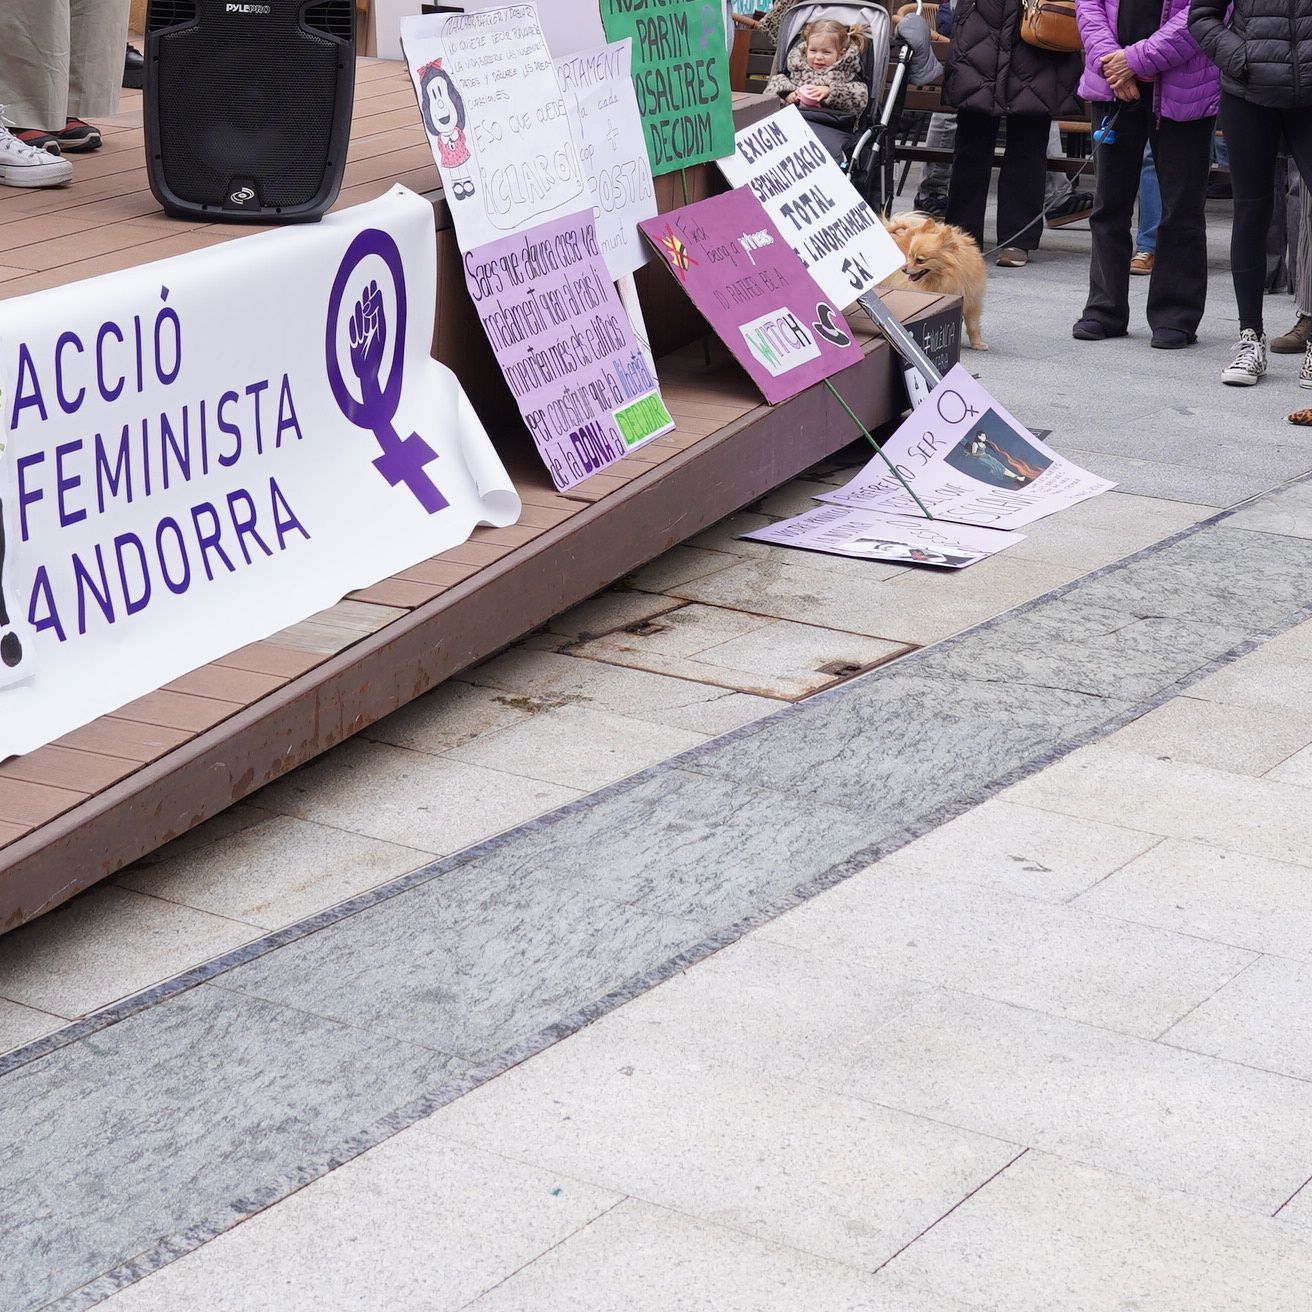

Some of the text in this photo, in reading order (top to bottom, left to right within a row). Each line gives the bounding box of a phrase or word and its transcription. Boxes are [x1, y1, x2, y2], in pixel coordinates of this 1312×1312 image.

[635, 12, 692, 63] PARIM
[632, 58, 719, 118] OSALTRES
[474, 120, 503, 153] ESO
[509, 112, 533, 134] QUE
[650, 112, 714, 166] DECIDIM
[736, 121, 789, 165] EXIGIM
[780, 184, 836, 231] TOTAL
[464, 224, 599, 302] Saps que alguna cosa va
[758, 270, 778, 294] BE
[774, 268, 790, 288] A
[483, 263, 609, 353] malament quan al país li
[9, 284, 182, 431] ACCIÓ
[502, 345, 554, 397] importen
[549, 338, 578, 381] més
[570, 324, 593, 367] els
[745, 313, 811, 369] WITCH
[525, 409, 552, 446] per
[547, 385, 596, 436] construir
[589, 377, 612, 413] que
[601, 368, 624, 404] la
[16, 372, 304, 542] FEMINISTA
[545, 394, 672, 489] de la DONA a DECIDIR
[908, 430, 947, 466] SER
[27, 475, 312, 644] ANDORRA
